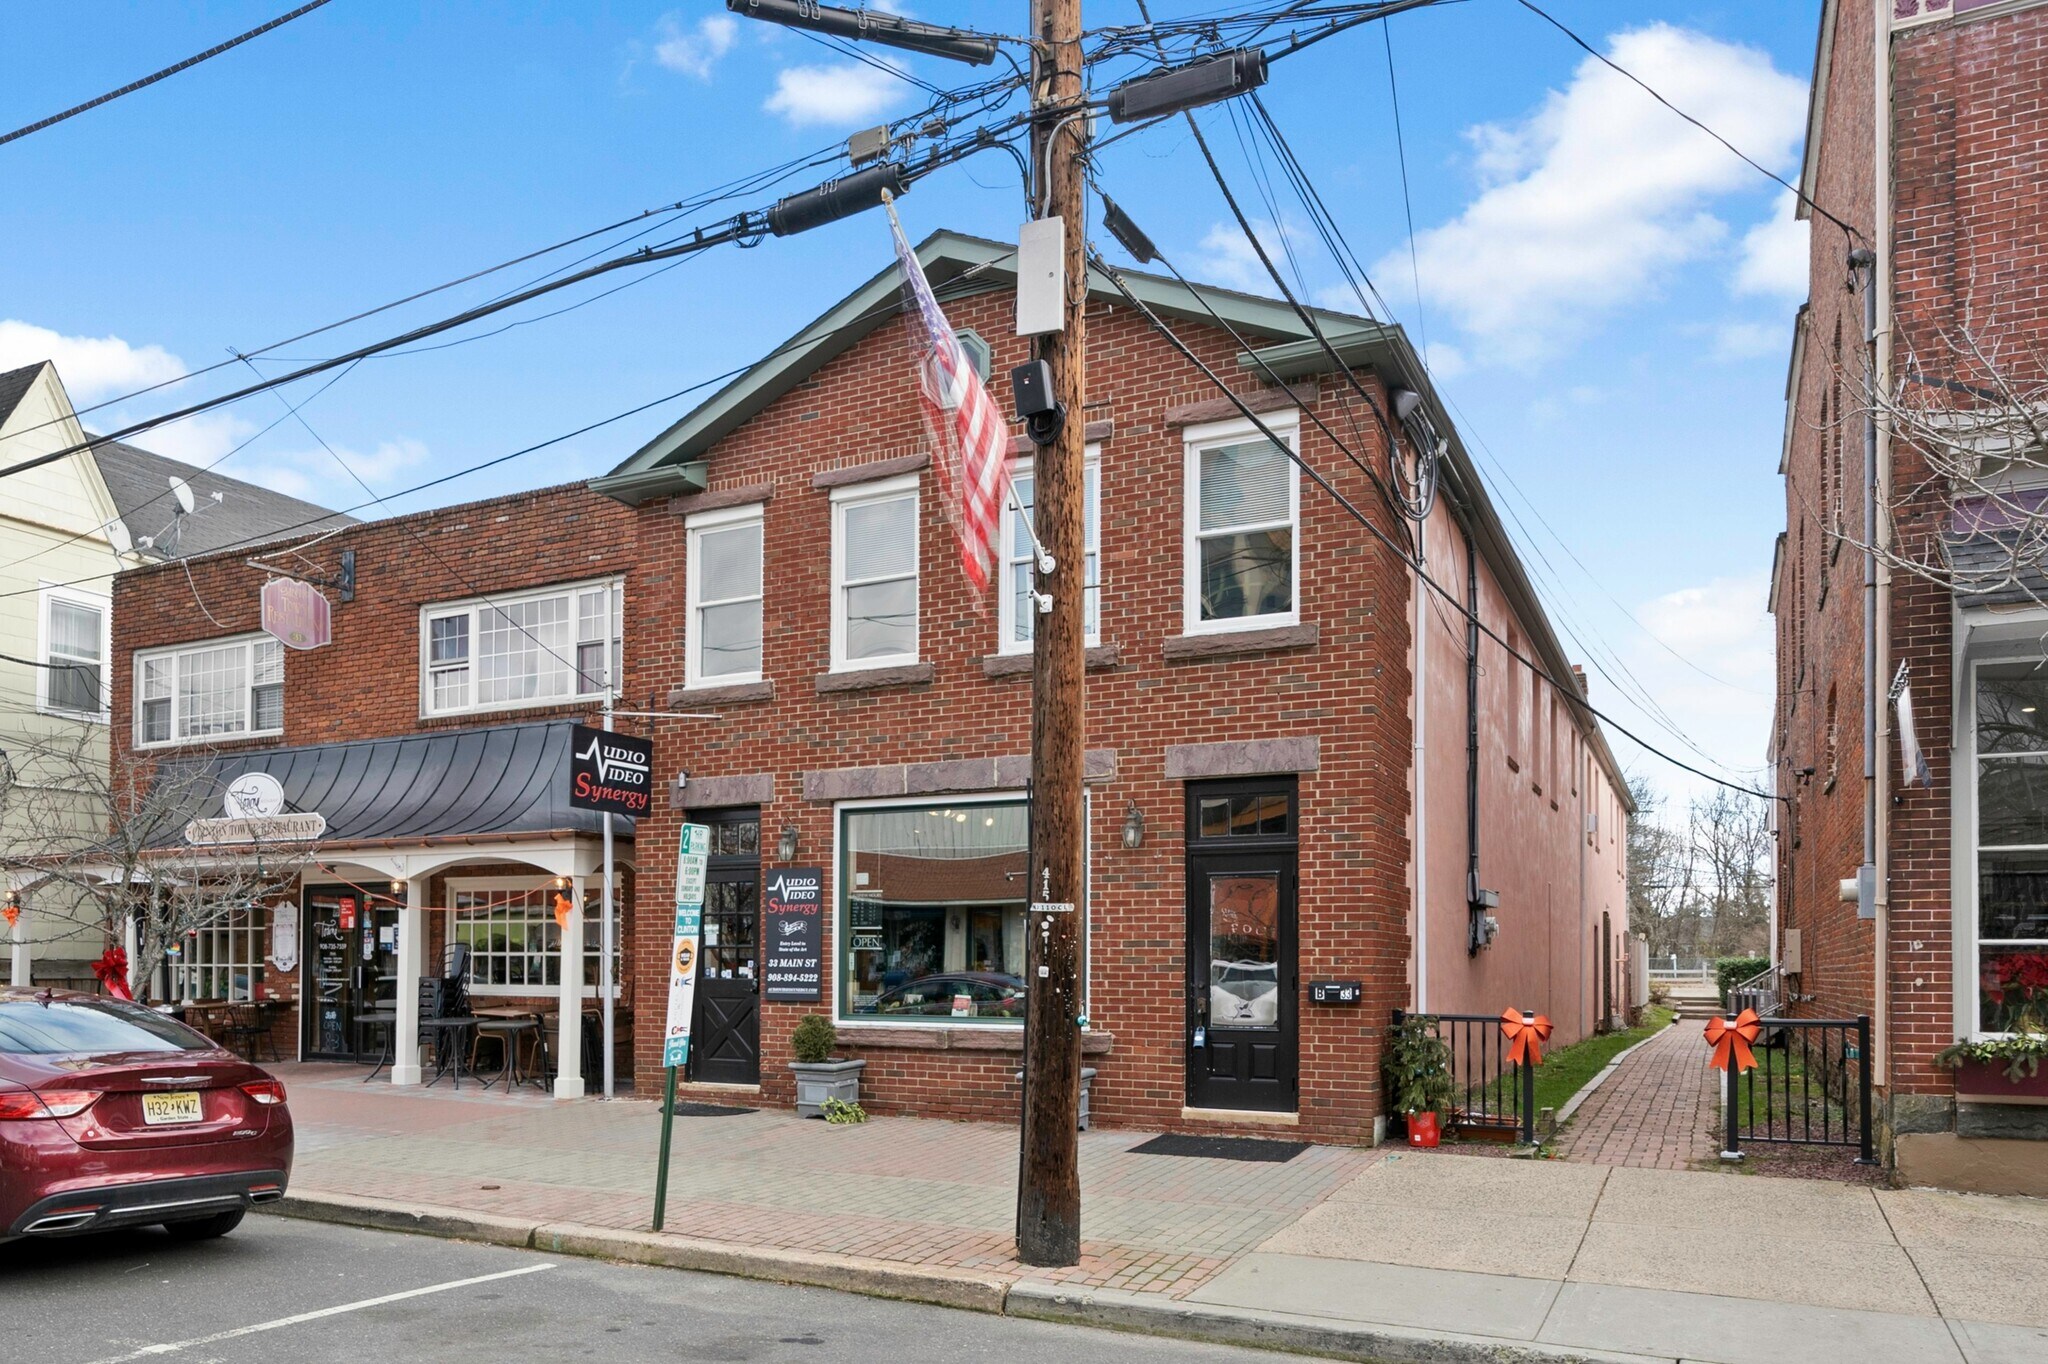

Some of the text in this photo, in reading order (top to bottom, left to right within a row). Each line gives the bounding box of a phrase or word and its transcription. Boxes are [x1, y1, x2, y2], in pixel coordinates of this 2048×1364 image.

[574, 772, 648, 809] Synergy
[682, 829, 690, 849] 2
[767, 897, 819, 915] Synergy
[678, 909, 700, 917] WELCOME
[685, 917, 692, 925] TO
[677, 925, 699, 934] CLINTON
[852, 937, 880, 948] OPEN
[768, 958, 818, 968] 33 MAIN ST
[767, 973, 819, 982] 908-894-5222
[1340, 987, 1352, 999] 33
[147, 1099, 198, 1116] H32 KWZ
